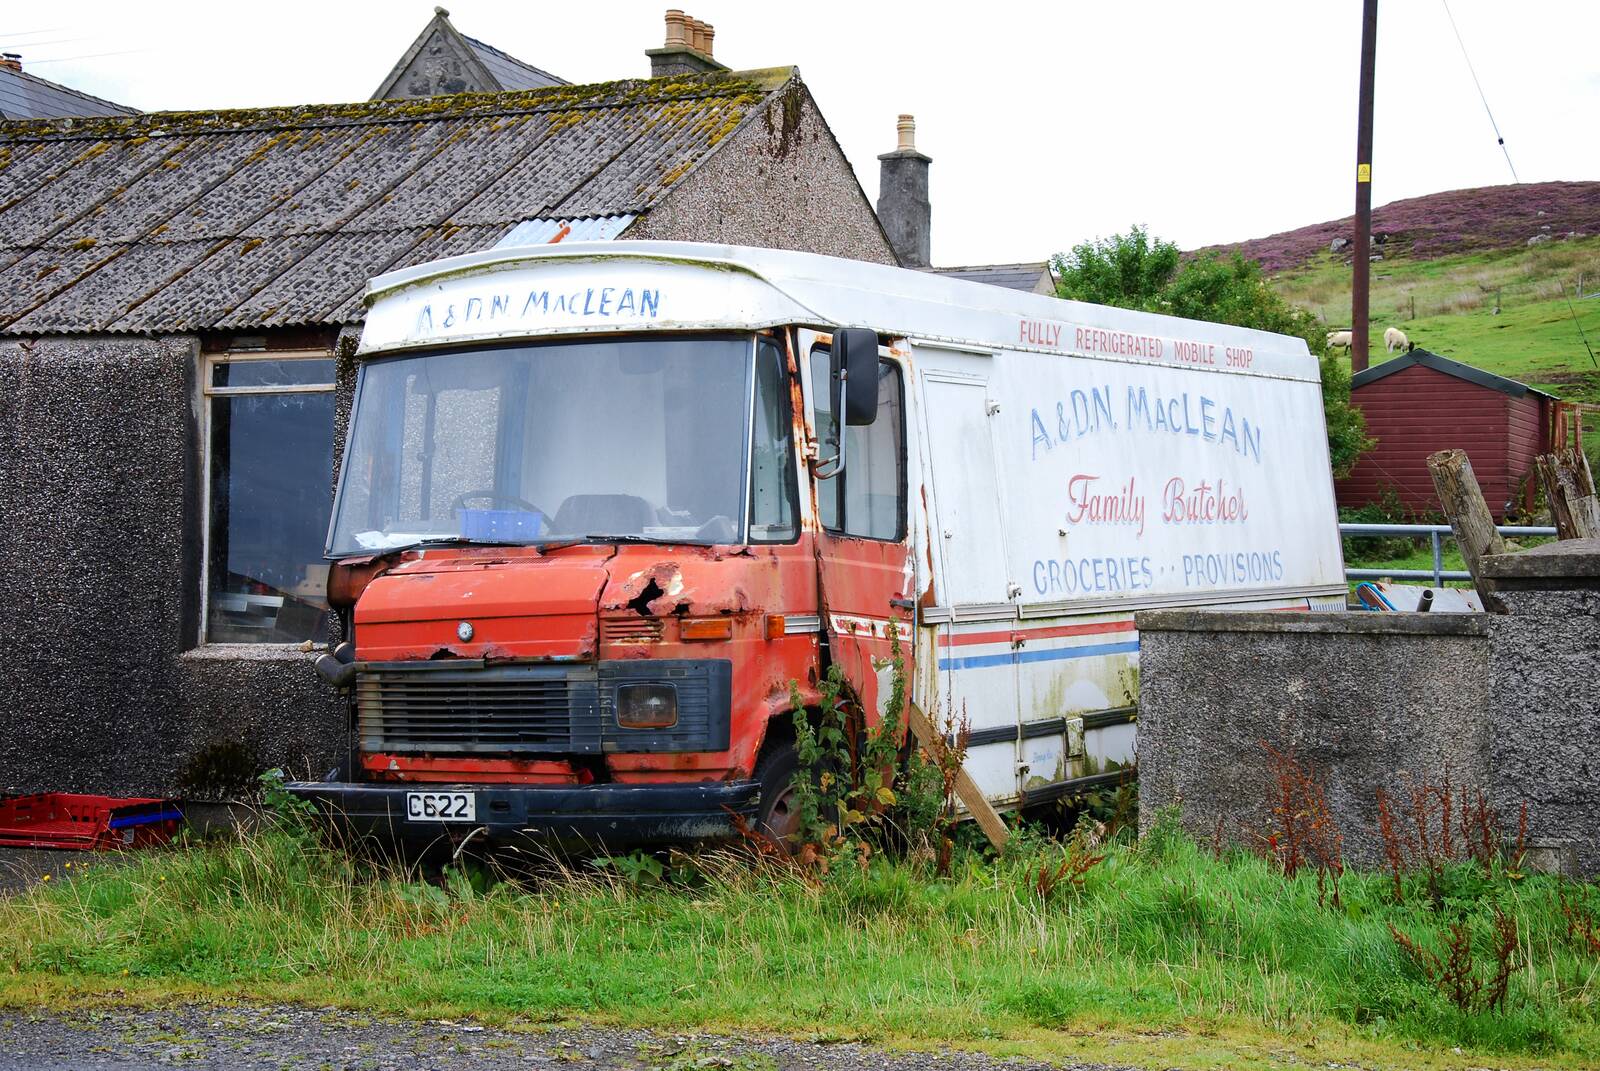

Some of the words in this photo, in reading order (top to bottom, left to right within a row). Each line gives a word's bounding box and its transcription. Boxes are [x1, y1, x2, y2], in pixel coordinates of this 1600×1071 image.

[1019, 319, 1062, 348] FULLY
[1075, 328, 1163, 359] REFRIGERATED
[1173, 340, 1216, 365] MOBILE
[1225, 346, 1254, 369] SHOP
[1066, 473, 1145, 537] Family
[1162, 476, 1249, 523] Butcher
[1033, 556, 1153, 595] GROCERIES
[1182, 550, 1284, 587] PROVISIONS
